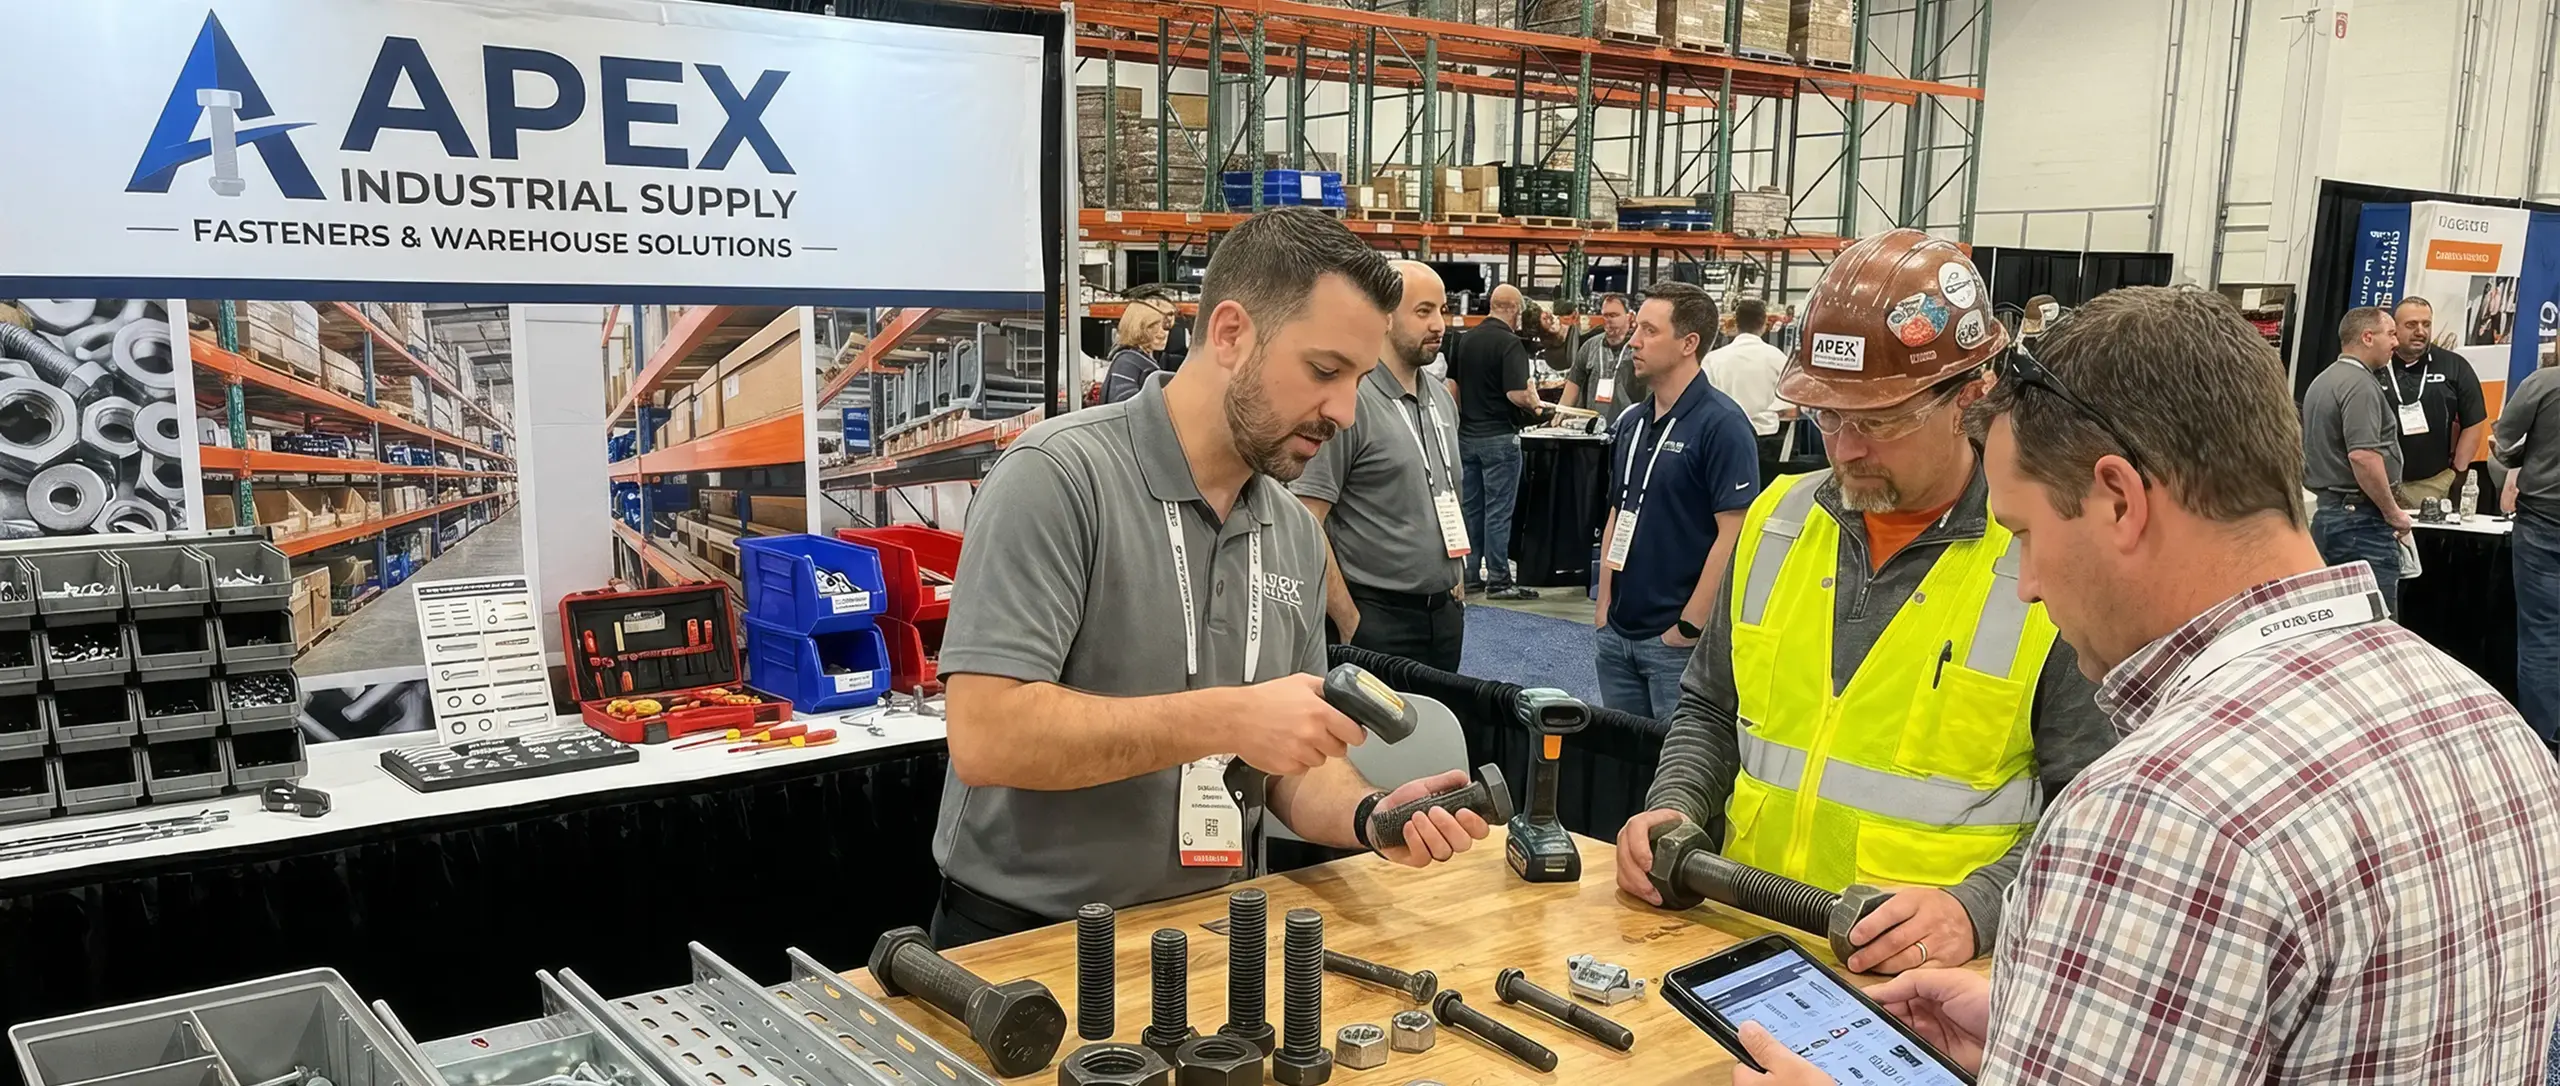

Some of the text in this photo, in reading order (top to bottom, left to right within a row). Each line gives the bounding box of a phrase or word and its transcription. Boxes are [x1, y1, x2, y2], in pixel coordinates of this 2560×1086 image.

[340, 36, 797, 175] APEX
[341, 168, 797, 219] INDUSTRIAL SUPPLY
[193, 219, 792, 258] FASTENERS & WAREHOUSE SOLUTIONS
